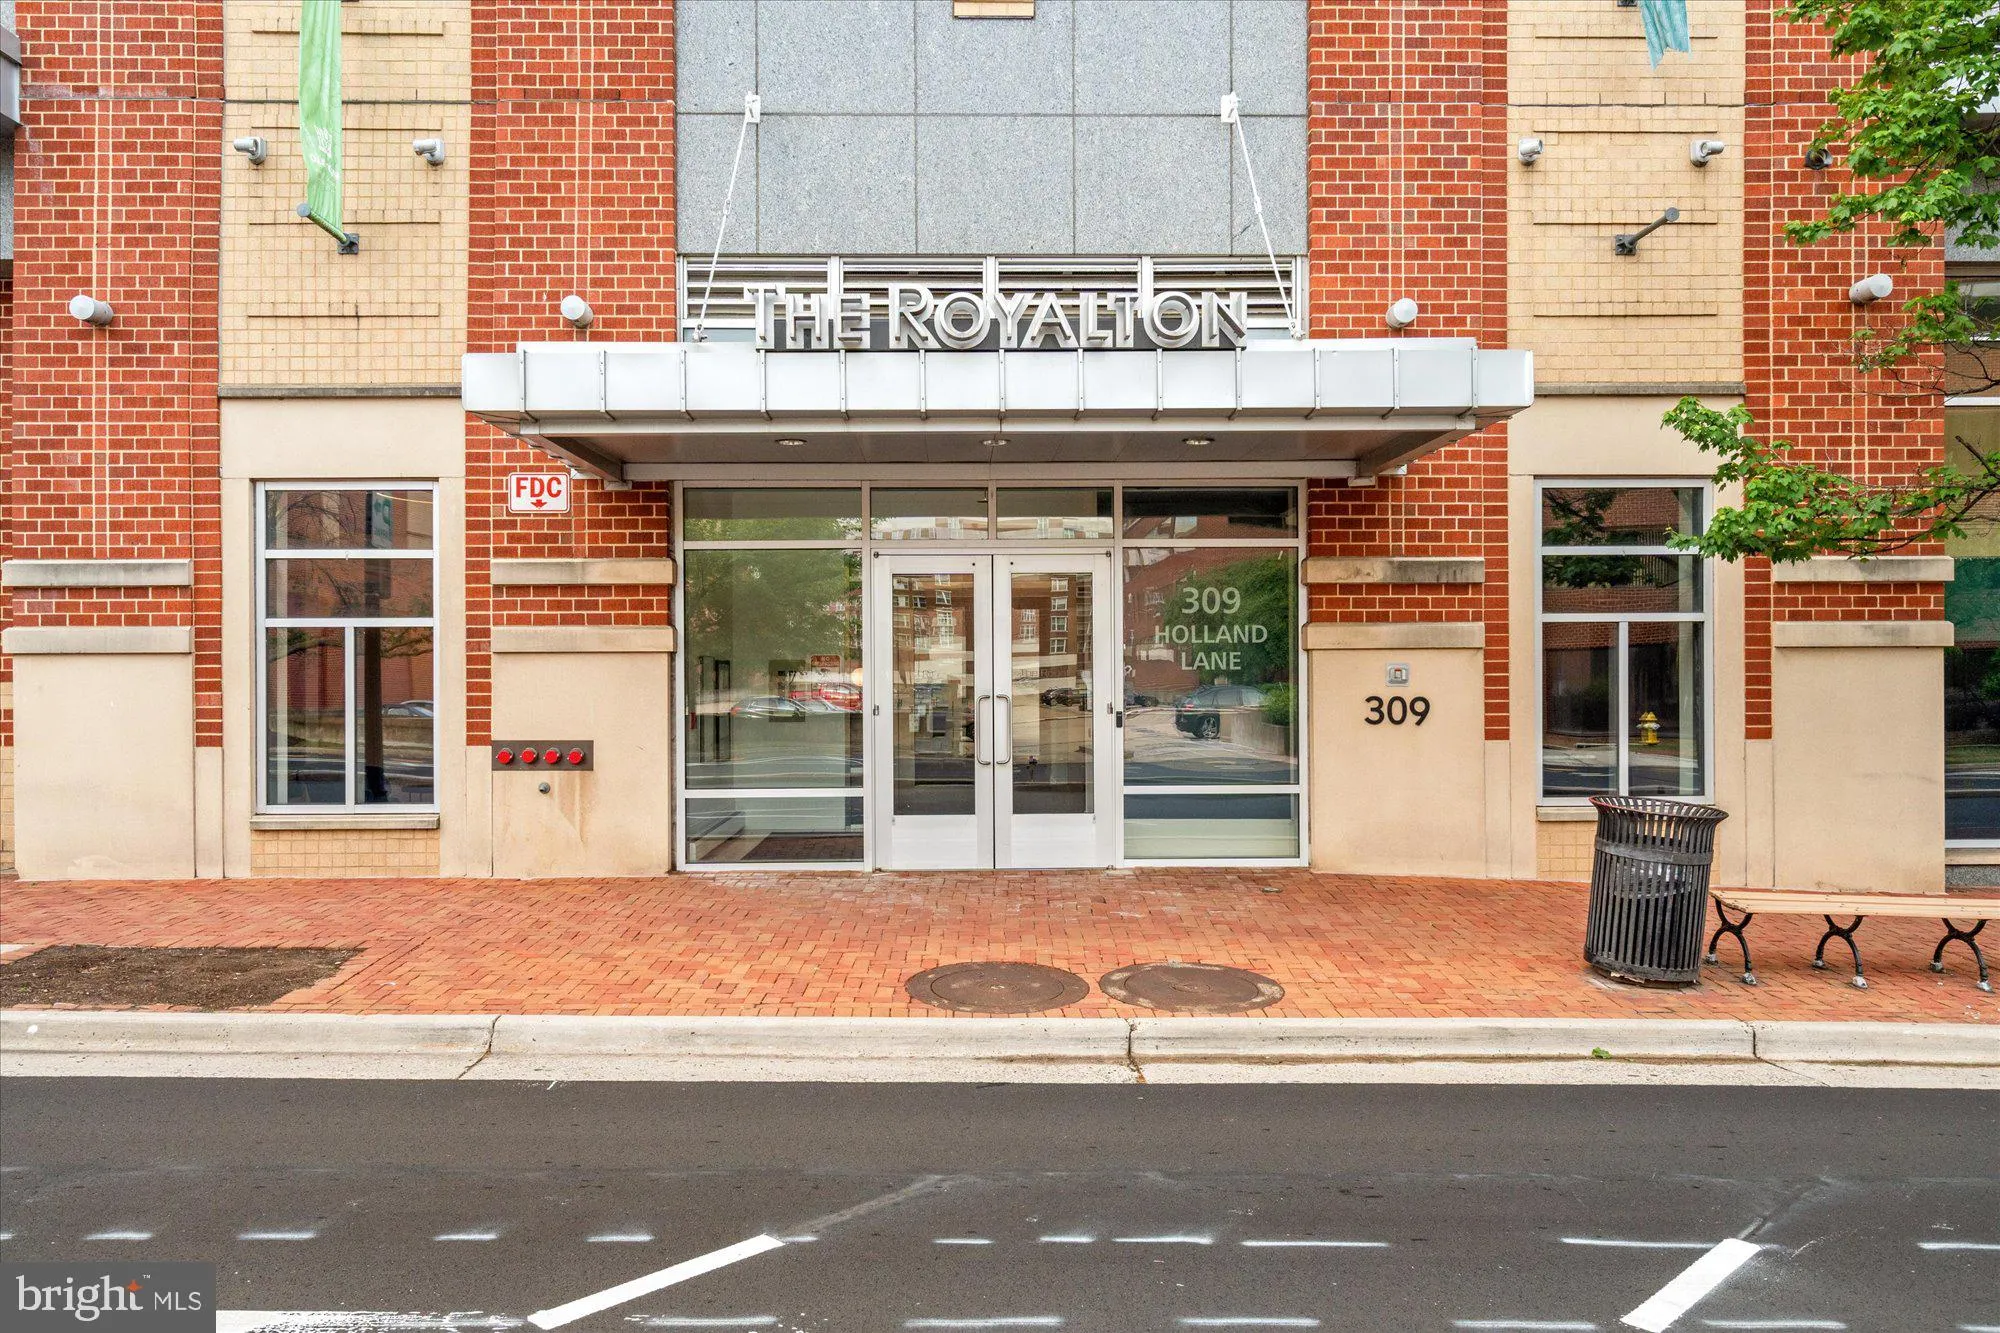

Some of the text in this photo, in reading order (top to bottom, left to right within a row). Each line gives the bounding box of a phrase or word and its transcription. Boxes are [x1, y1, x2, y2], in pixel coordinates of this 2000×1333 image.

[744, 283, 1248, 349] THE ROYALTON
[515, 476, 562, 498] FDC
[1181, 586, 1241, 614] 309
[1154, 624, 1268, 644] HOLLAND
[1181, 651, 1242, 670] LANE
[1364, 695, 1431, 726] 309
